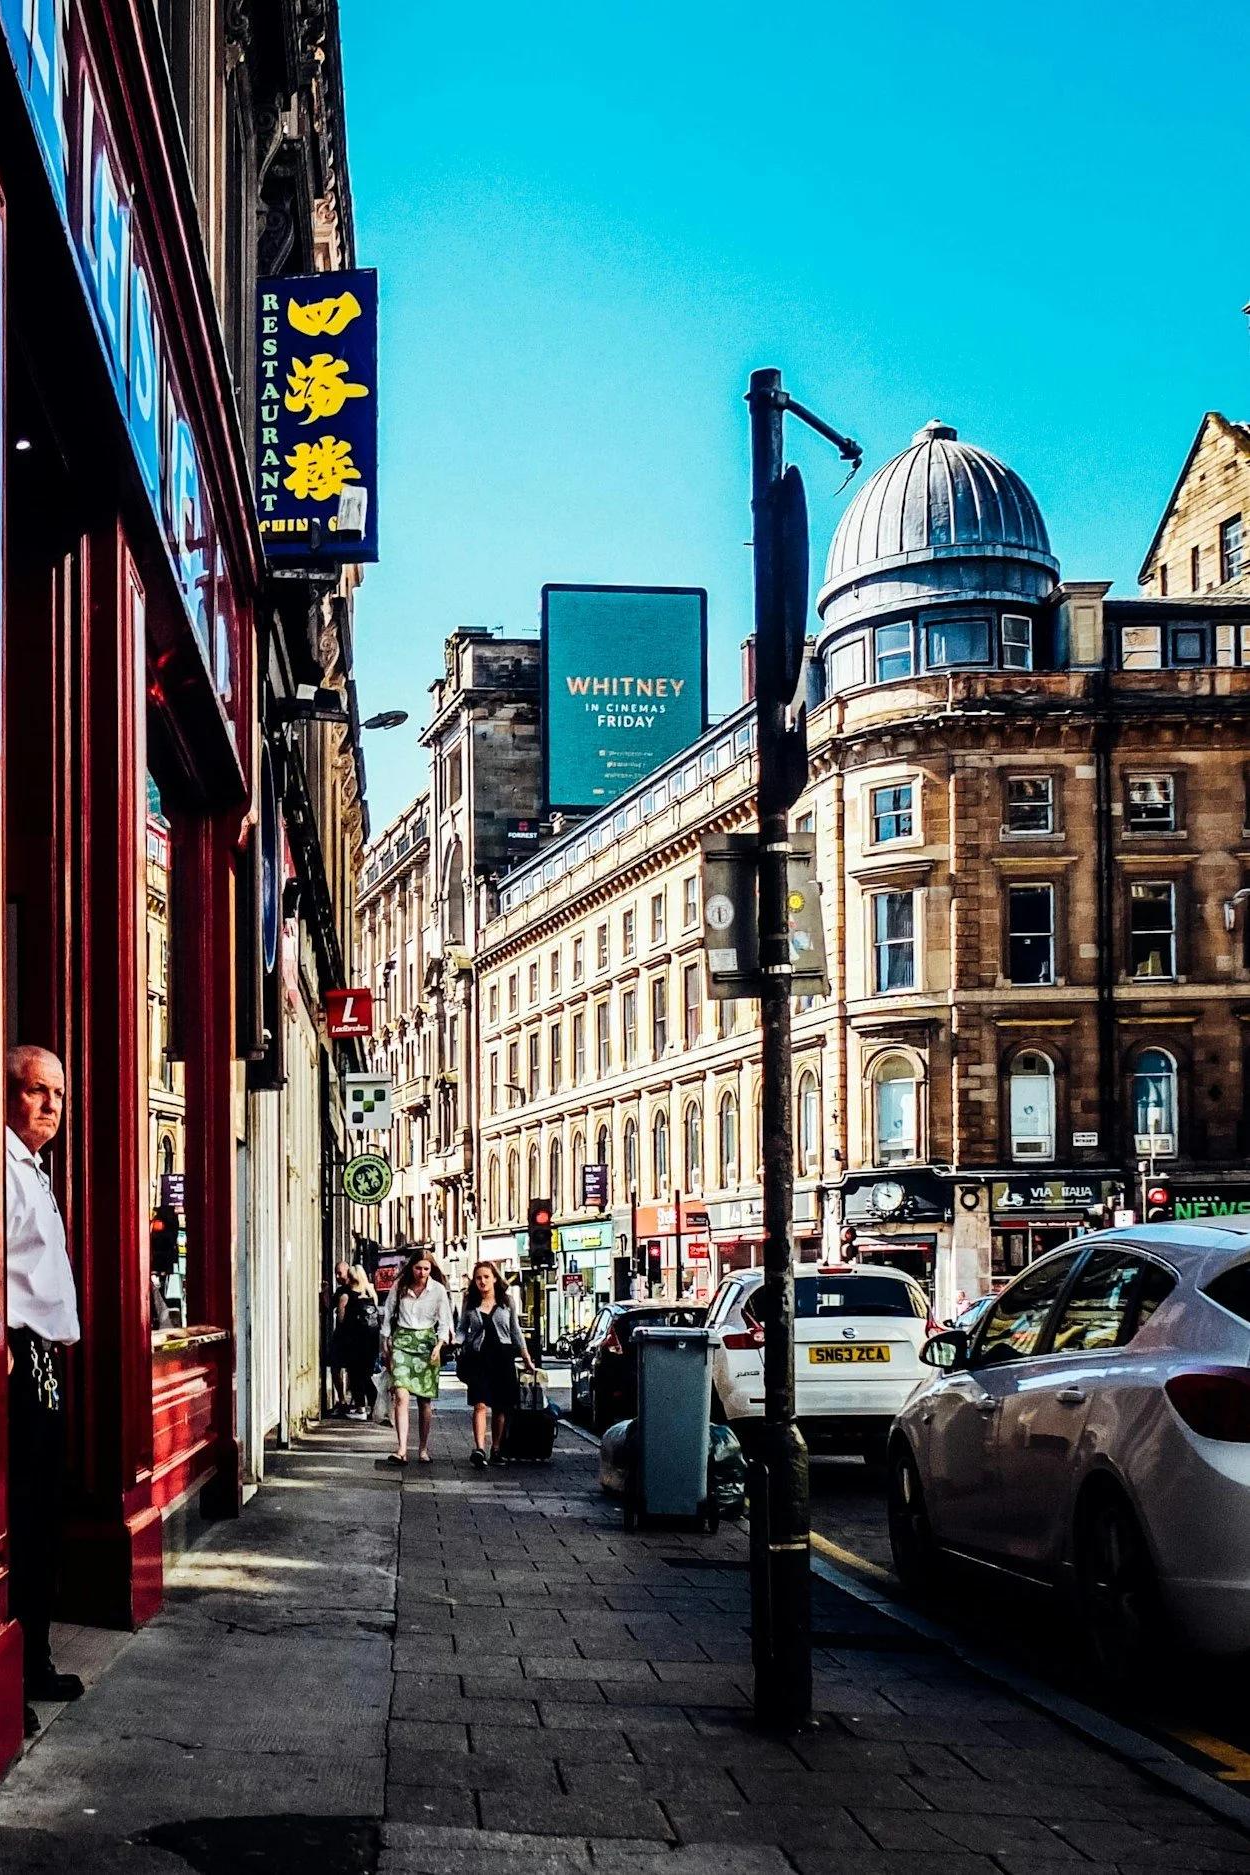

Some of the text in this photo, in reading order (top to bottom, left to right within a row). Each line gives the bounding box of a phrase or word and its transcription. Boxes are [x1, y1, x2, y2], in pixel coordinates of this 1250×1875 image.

[260, 293, 280, 513] RESTAURANT
[566, 676, 686, 698] WHITNEY
[585, 703, 667, 714] IN CINEMAS
[597, 715, 656, 728] FRIDAY
[342, 997, 359, 1023] L
[331, 1024, 369, 1033] Ladbrokes
[1030, 1186, 1093, 1197] VIA ITALIA
[816, 1347, 885, 1362] SN63 ZCA
